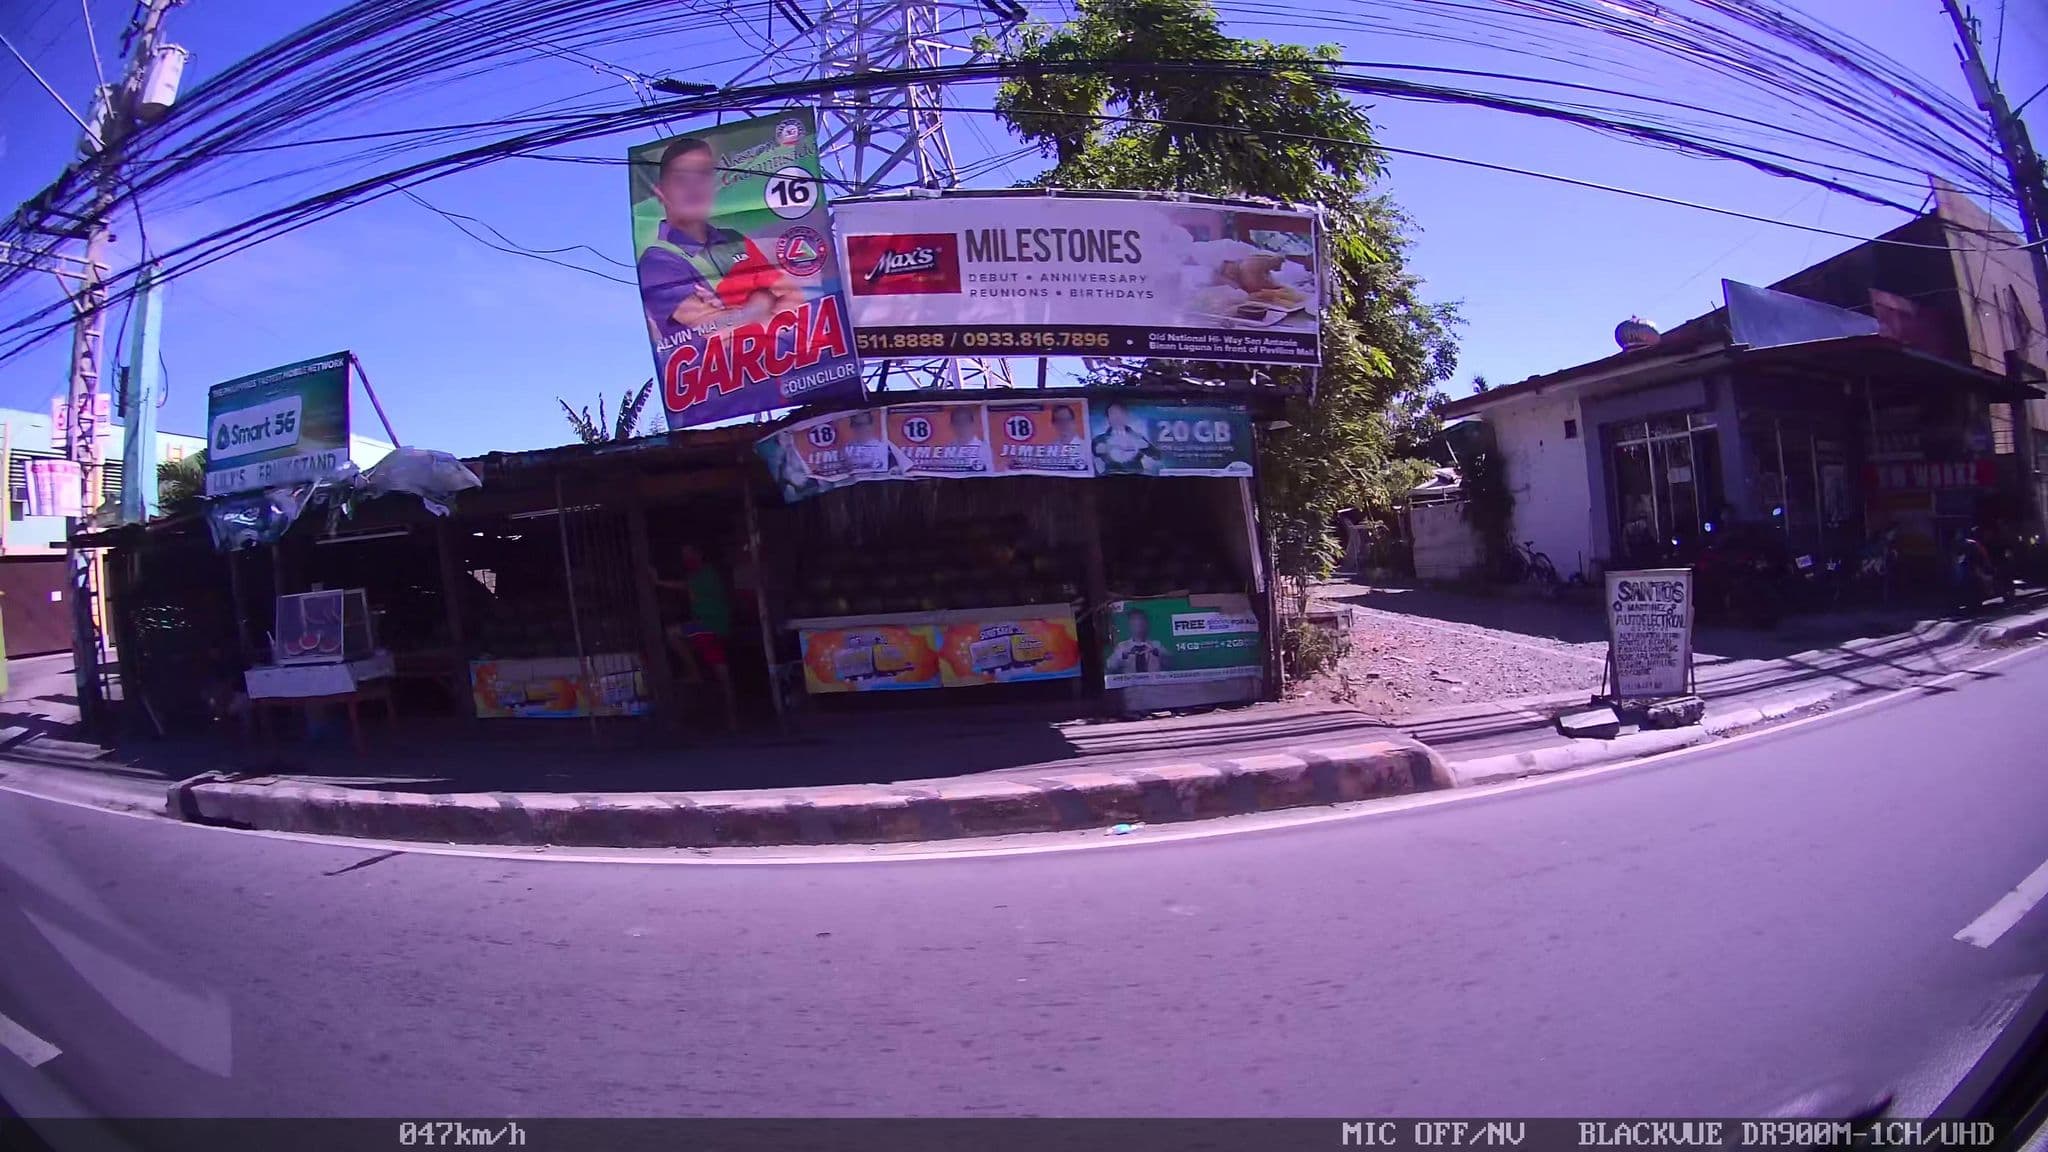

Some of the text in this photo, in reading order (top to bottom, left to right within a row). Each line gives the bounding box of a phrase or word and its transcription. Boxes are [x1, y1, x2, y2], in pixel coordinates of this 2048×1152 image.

[771, 179, 810, 207] 16
[965, 227, 1143, 265] MILESTONES
[863, 246, 935, 282] Max's
[968, 272, 1148, 285] DEBUT ANNIVERSARY
[968, 287, 1155, 300] REUNIONS BIRTHDAYS
[656, 328, 693, 353] ALVIN
[856, 333, 945, 350] 511.8888
[962, 331, 1111, 348] 0933.816.7896
[1148, 332, 1167, 342] Old
[1167, 333, 1207, 343] National
[1222, 335, 1243, 346] Way
[663, 294, 850, 413] GARCIA
[1178, 343, 1212, 352] Laguna
[1213, 343, 1223, 353] in
[1225, 345, 1247, 353] front
[1248, 345, 1259, 355] of
[308, 358, 344, 375] NETWORK
[781, 363, 857, 395] COUNCILOR
[231, 410, 296, 445] Smart 5G
[810, 426, 831, 443] 18
[905, 421, 928, 437] 18
[1007, 419, 1030, 437] 18
[1156, 419, 1232, 443] 20 GB
[1617, 580, 1685, 604] SANTOS
[1174, 619, 1206, 631] FREE
